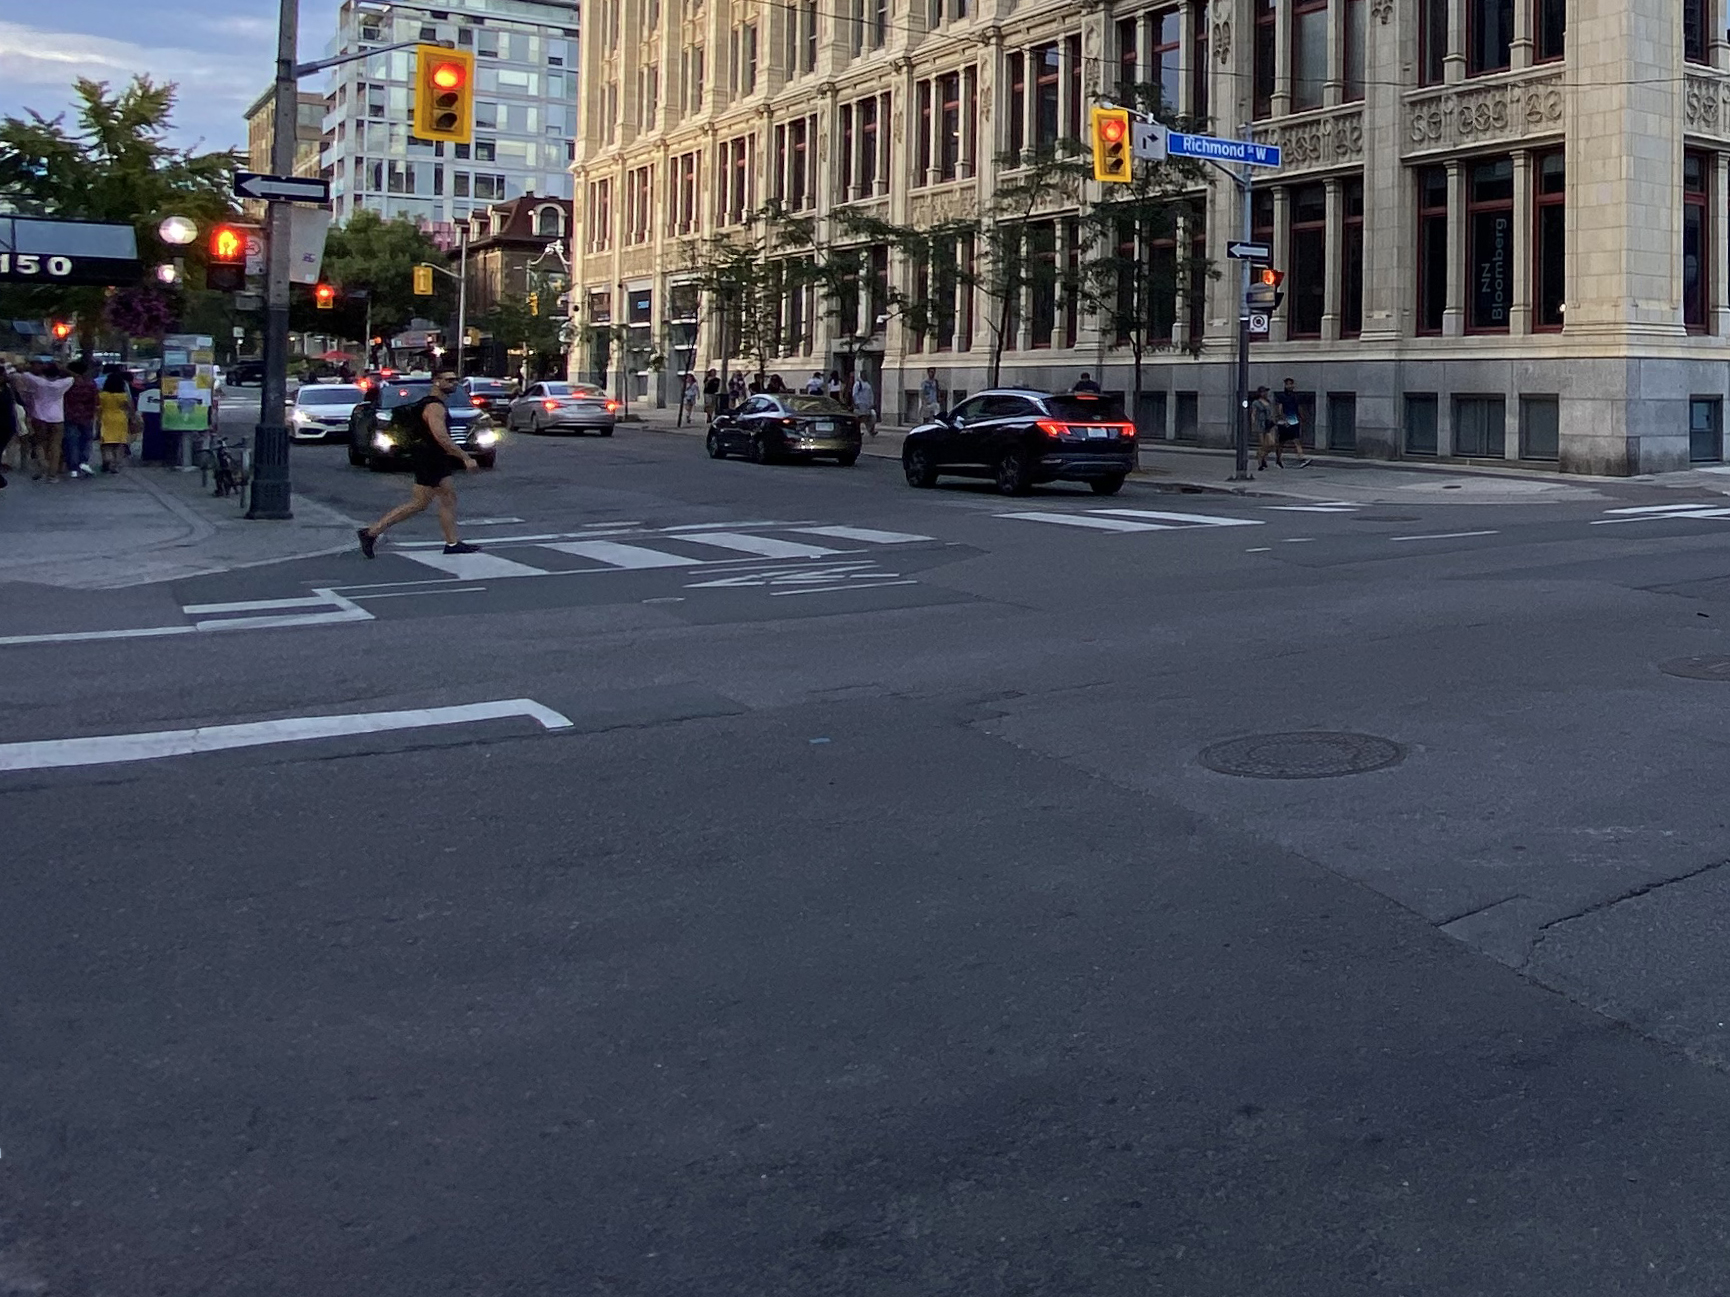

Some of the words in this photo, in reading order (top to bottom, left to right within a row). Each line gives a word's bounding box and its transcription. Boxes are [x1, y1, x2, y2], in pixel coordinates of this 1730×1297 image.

[1183, 136, 1245, 158] Richmond
[1255, 147, 1267, 161] W
[0, 253, 73, 276] 150
[1492, 218, 1507, 320] Bloomberg
